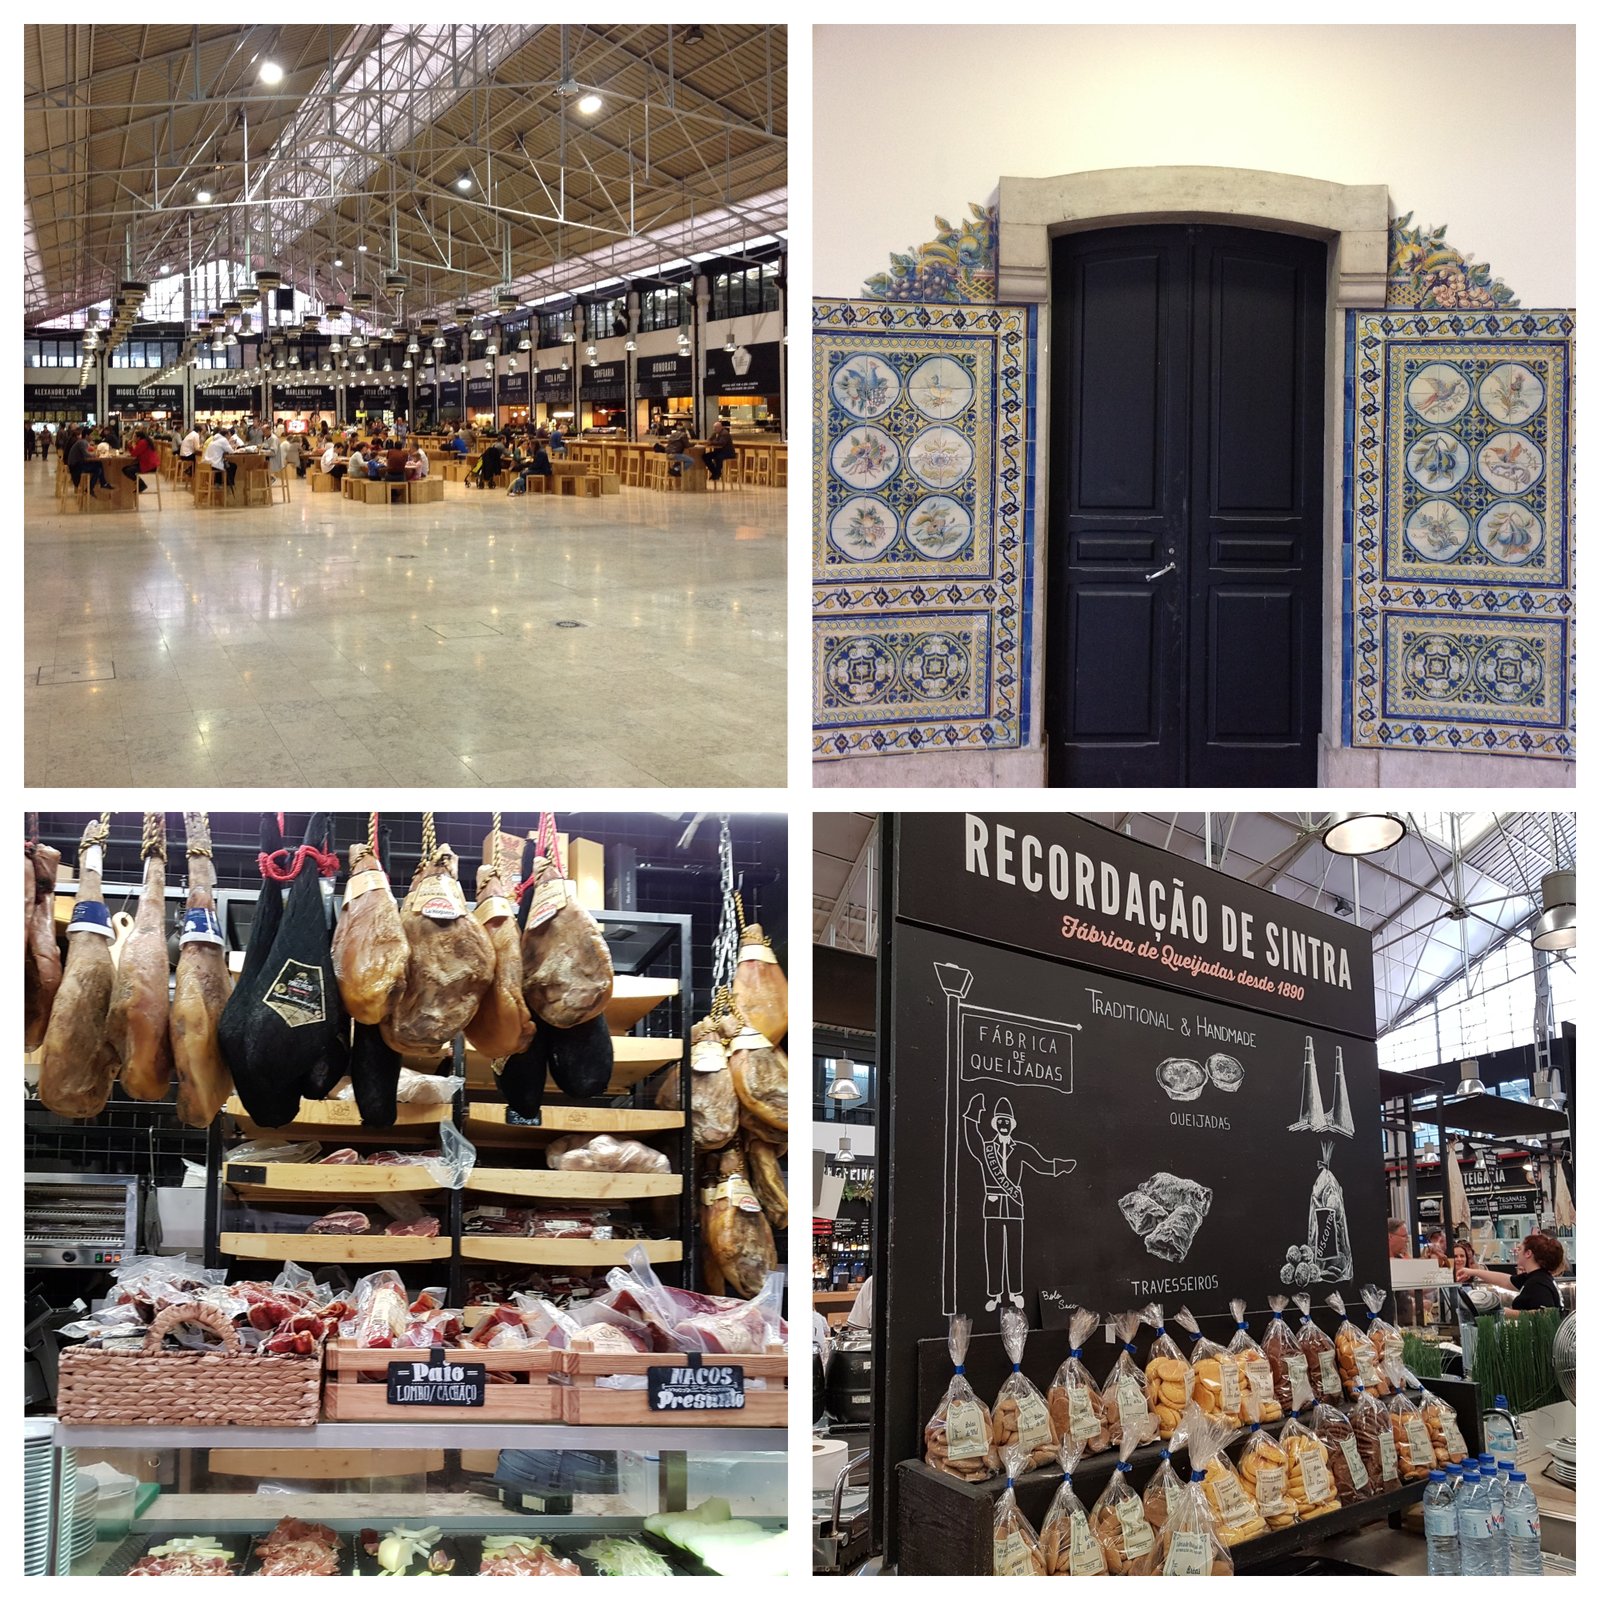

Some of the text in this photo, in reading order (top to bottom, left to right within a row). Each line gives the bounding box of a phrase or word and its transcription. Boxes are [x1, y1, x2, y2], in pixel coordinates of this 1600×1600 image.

[652, 360, 677, 373] HONORATO
[34, 388, 82, 396] ALEXANDRE SILVA
[116, 388, 135, 396] MIGUEL
[136, 388, 156, 396] CASTRO
[161, 388, 176, 396] SILVA
[202, 388, 226, 396] HENRIQUE
[285, 388, 323, 396] MARLENE VIEIRA
[965, 812, 1353, 991] RECORDAÇÃO DE SINTRA
[1061, 914, 1305, 1001] Fábrica de Queijadas desde 1890
[1084, 987, 1257, 1048] TRADITIONAL & HANDMADE
[979, 1024, 1058, 1055] FÁBRICA
[1012, 1050, 1026, 1061] DE
[970, 1053, 1063, 1082] QUEIJADAS
[1169, 1111, 1231, 1131] QUEIJADAS
[986, 1144, 1019, 1199] QUEIJADAS
[1131, 1274, 1219, 1296] TRAVESSEIROS
[411, 1360, 465, 1382] Paio
[669, 1366, 734, 1385] NACOS
